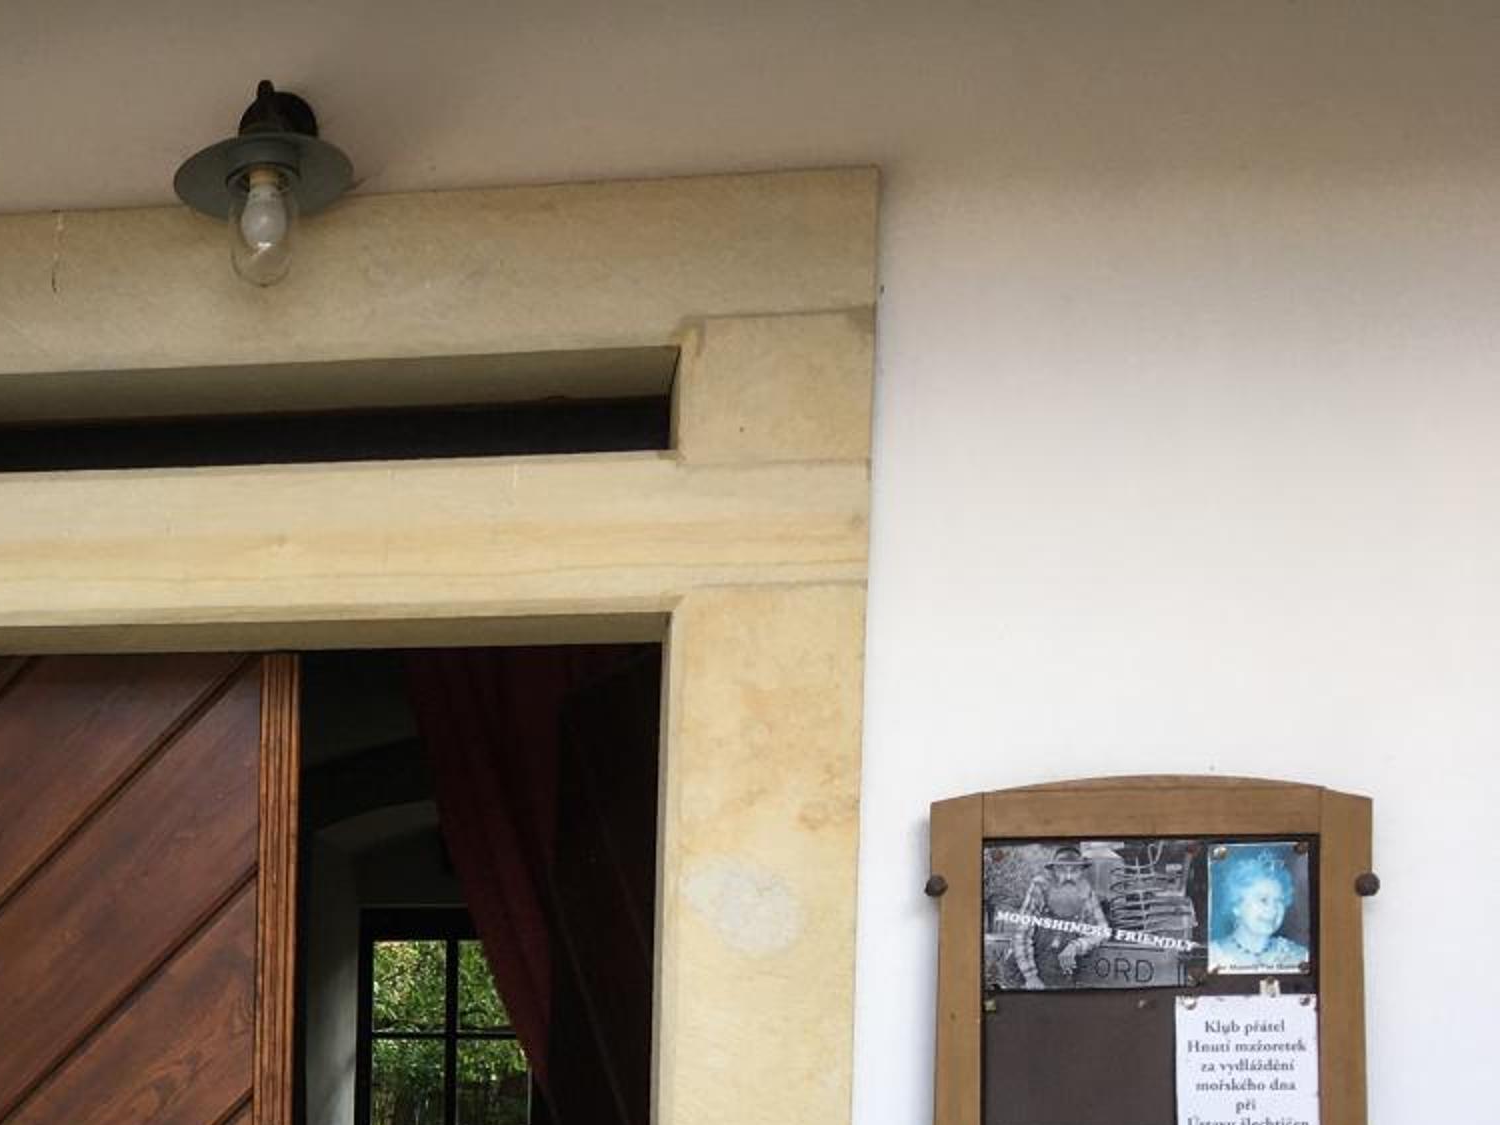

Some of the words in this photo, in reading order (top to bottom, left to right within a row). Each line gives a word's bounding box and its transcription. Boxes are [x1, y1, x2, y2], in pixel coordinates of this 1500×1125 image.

[1114, 925, 1198, 952] FRIENDLY
[1201, 1063, 1216, 1072] za
[1269, 1077, 1297, 1091] dna
[1235, 1098, 1257, 1114] při
